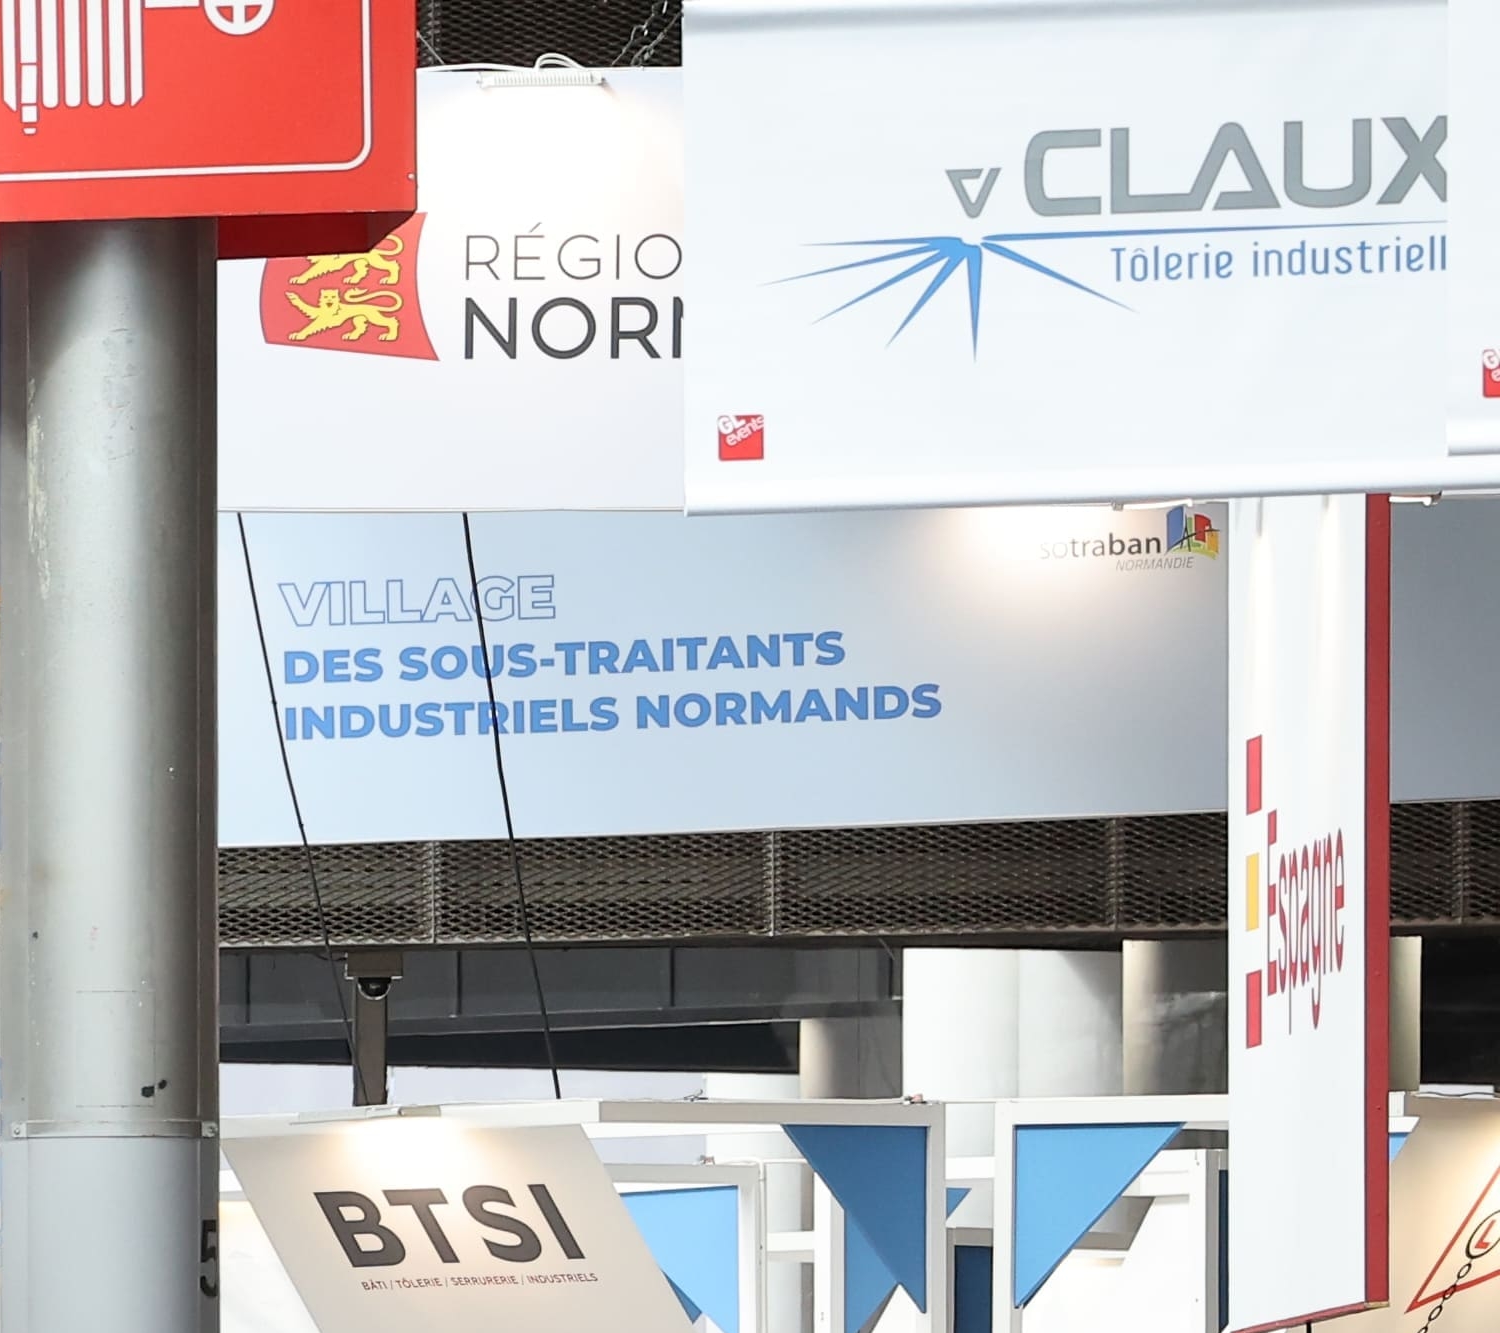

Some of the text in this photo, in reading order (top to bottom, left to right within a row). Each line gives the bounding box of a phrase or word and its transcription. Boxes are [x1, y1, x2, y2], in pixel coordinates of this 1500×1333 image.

[1024, 115, 1448, 218] CLAUX
[465, 222, 682, 281] RÉGIO
[1111, 236, 1447, 284] Tôlerie industriell
[464, 297, 683, 361] NOR
[1039, 532, 1162, 561] sotraban
[1115, 555, 1194, 572] NORMANDIE
[278, 574, 556, 627] VILLAGE
[283, 631, 845, 685] DES SOUS-TRAITANTS
[283, 683, 941, 741] INDUSTRIELS NORMANDS
[1266, 809, 1345, 1036] Espagne
[313, 1184, 586, 1269] BTSI
[361, 1279, 387, 1291] BÂTI
[396, 1276, 442, 1289] TÔLERIE
[450, 1275, 518, 1287] SERRURERIE
[527, 1273, 598, 1284] INDUSTRIELS
